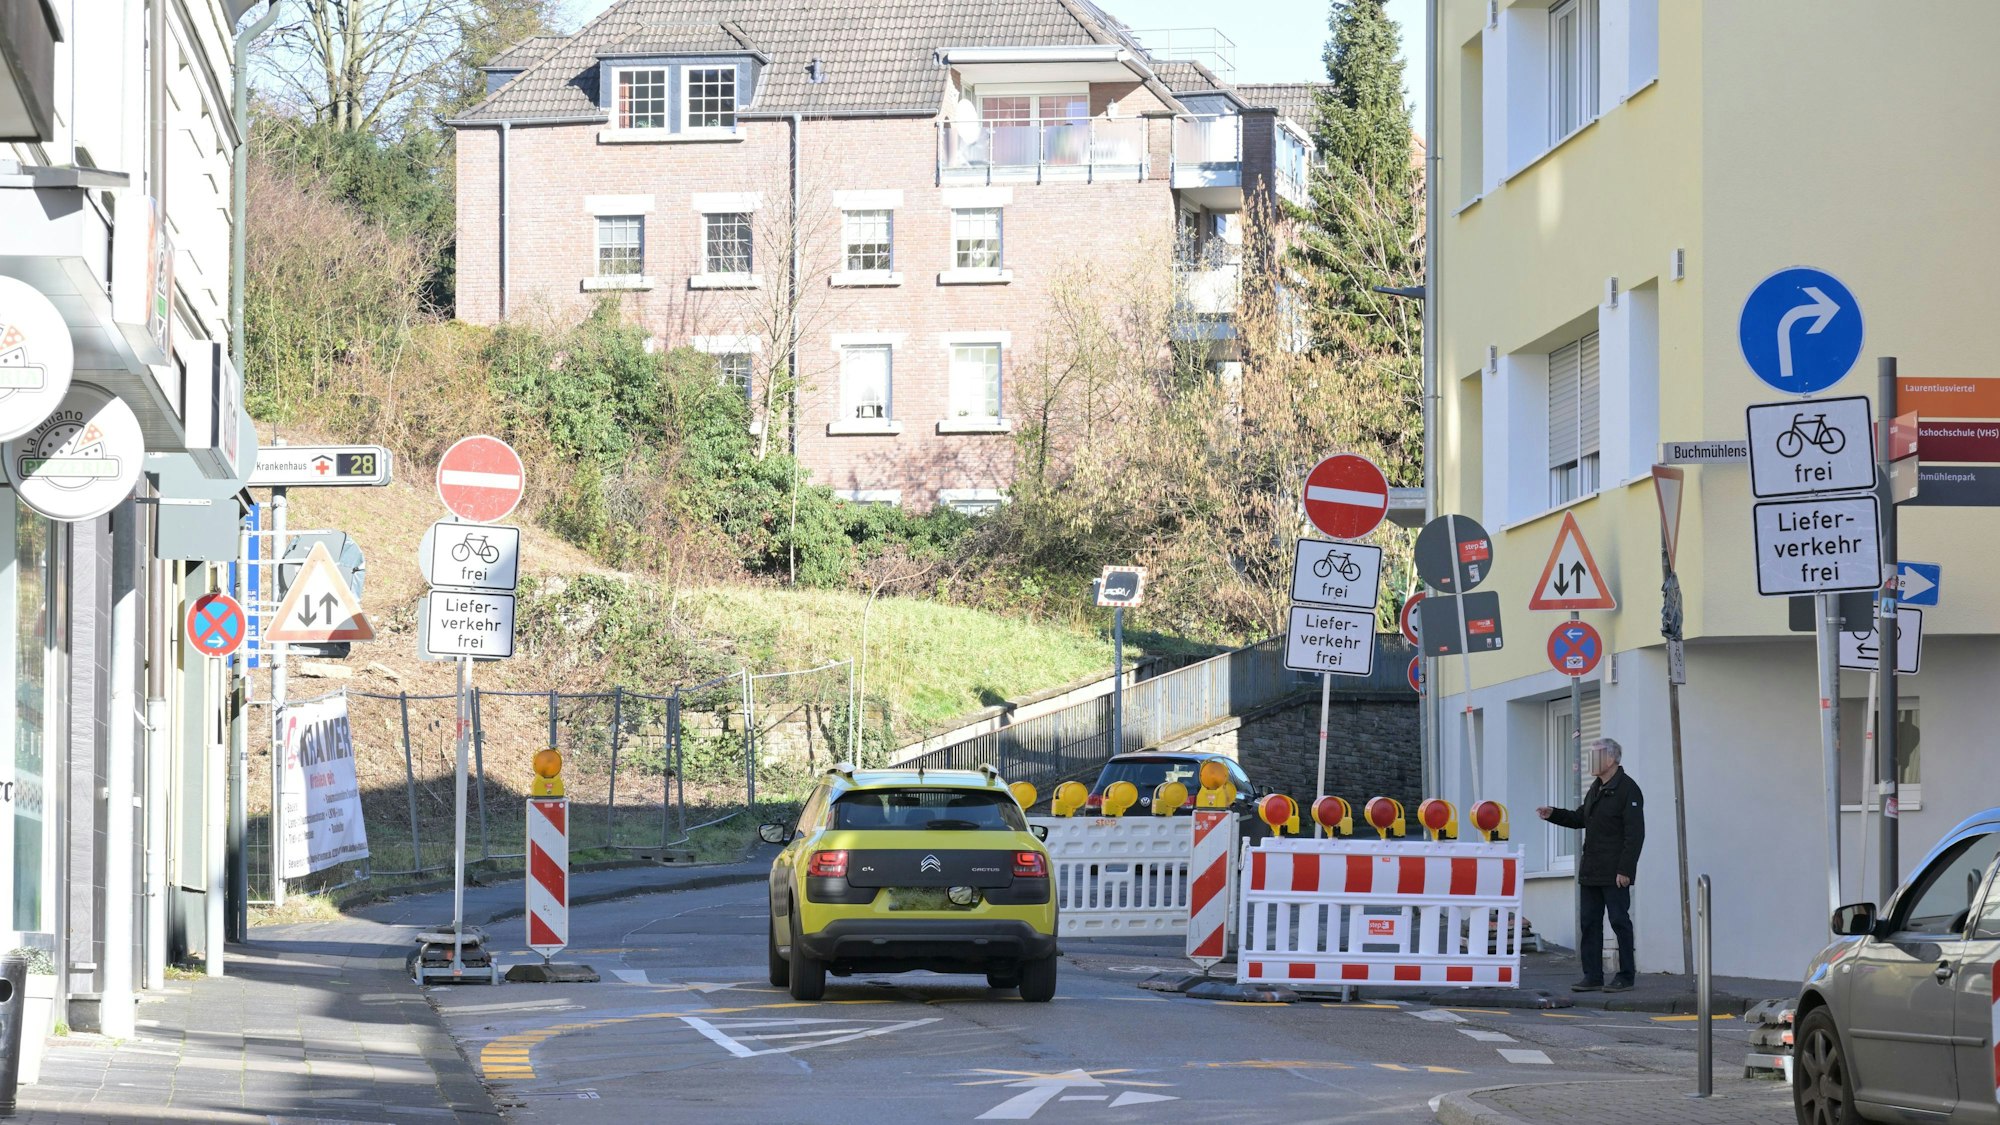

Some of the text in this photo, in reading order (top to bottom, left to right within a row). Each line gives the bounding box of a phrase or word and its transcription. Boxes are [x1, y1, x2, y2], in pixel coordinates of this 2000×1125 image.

[1905, 384, 1976, 393] Laurentiusviertel
[1976, 428, 2000, 439] (VHS)
[22, 437, 37, 454] La
[256, 454, 374, 475] Krankenhaus 28
[1794, 461, 1833, 484] frei
[1778, 509, 1855, 532] Liefer-
[1774, 535, 1862, 558] verkehr
[461, 567, 488, 581] frei
[1801, 561, 1840, 582] frei
[1322, 583, 1348, 599] frei
[445, 598, 499, 614] Liefer-
[441, 617, 502, 632] verkehr
[1305, 614, 1359, 631] Liefer-
[457, 634, 484, 649] frei
[1300, 632, 1361, 650] verkehr
[1316, 650, 1343, 666] frei
